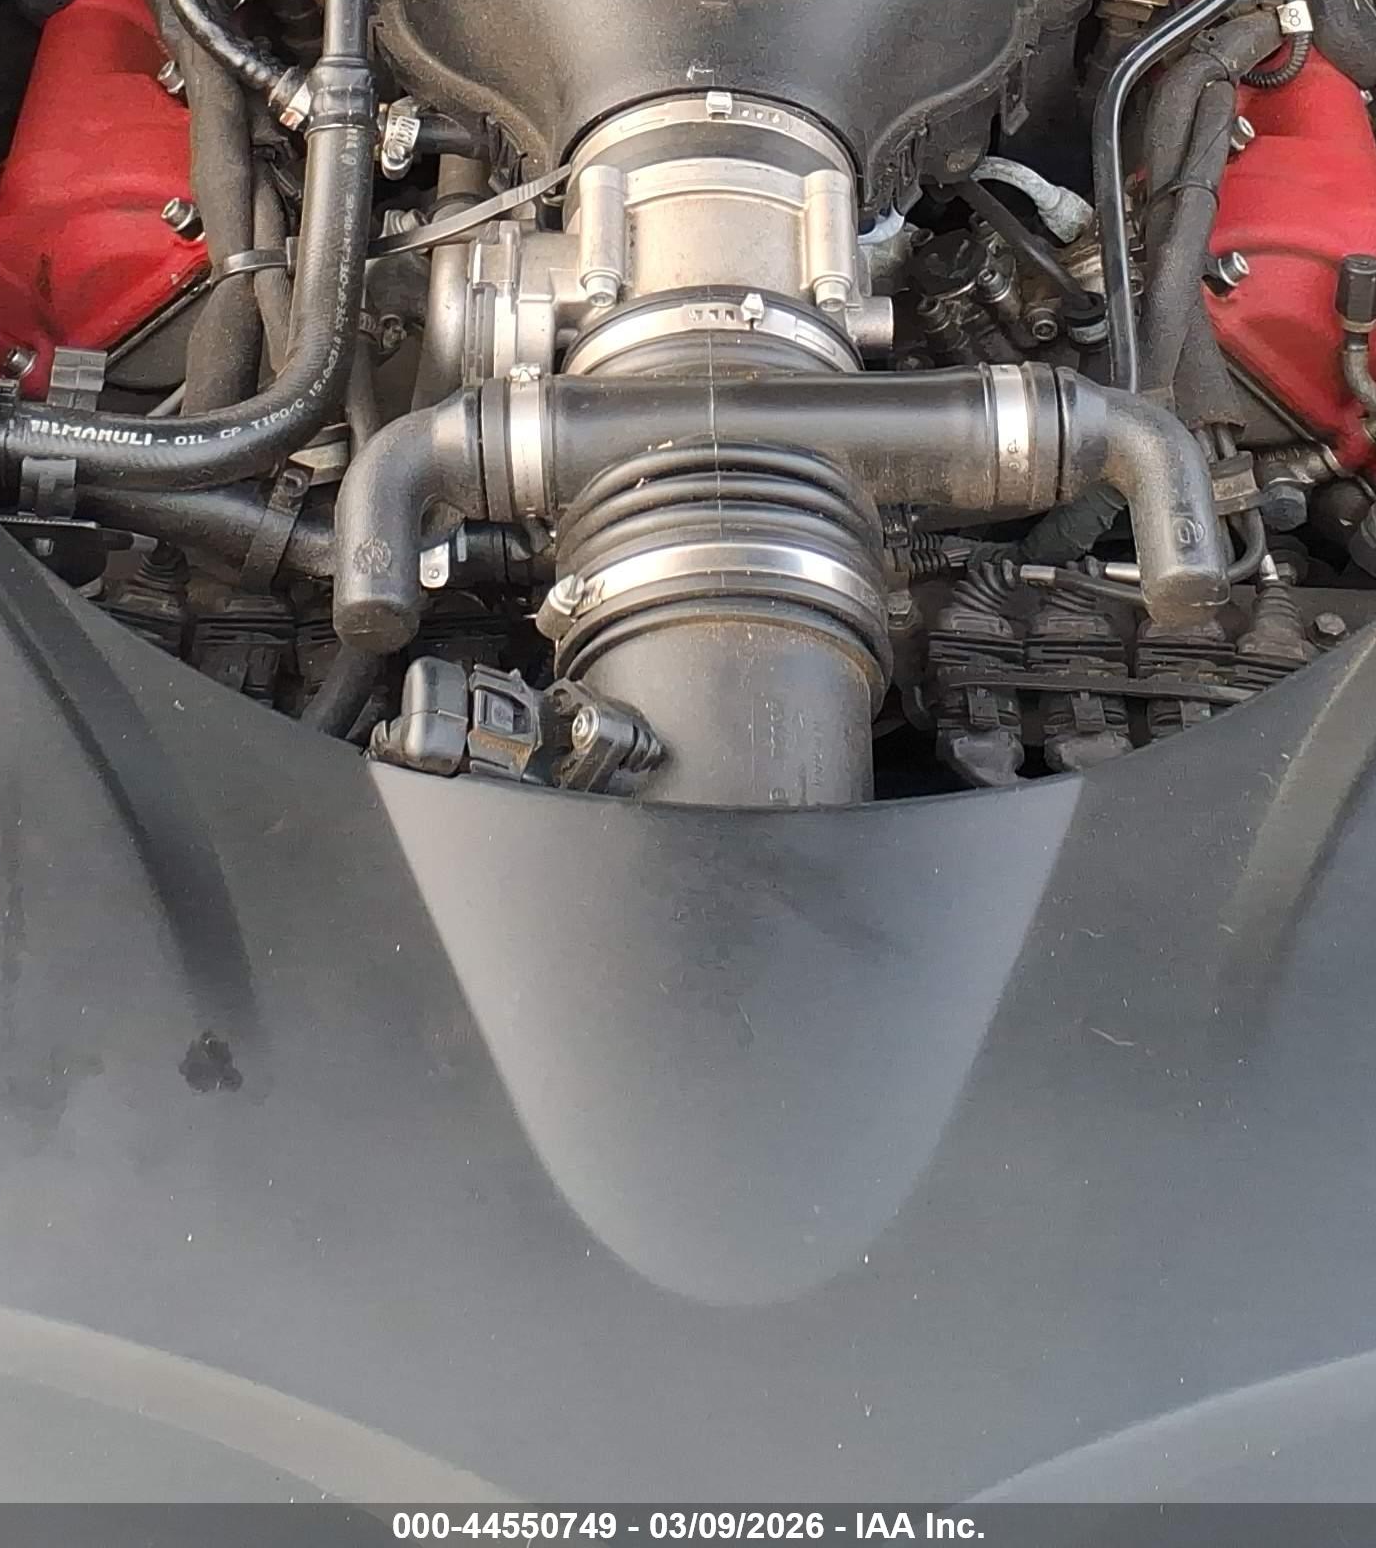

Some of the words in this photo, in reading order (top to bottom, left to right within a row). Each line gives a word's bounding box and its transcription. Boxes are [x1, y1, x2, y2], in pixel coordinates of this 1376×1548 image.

[174, 434, 211, 446] OIL
[219, 426, 242, 439] CP
[250, 398, 305, 431] TIPO/C
